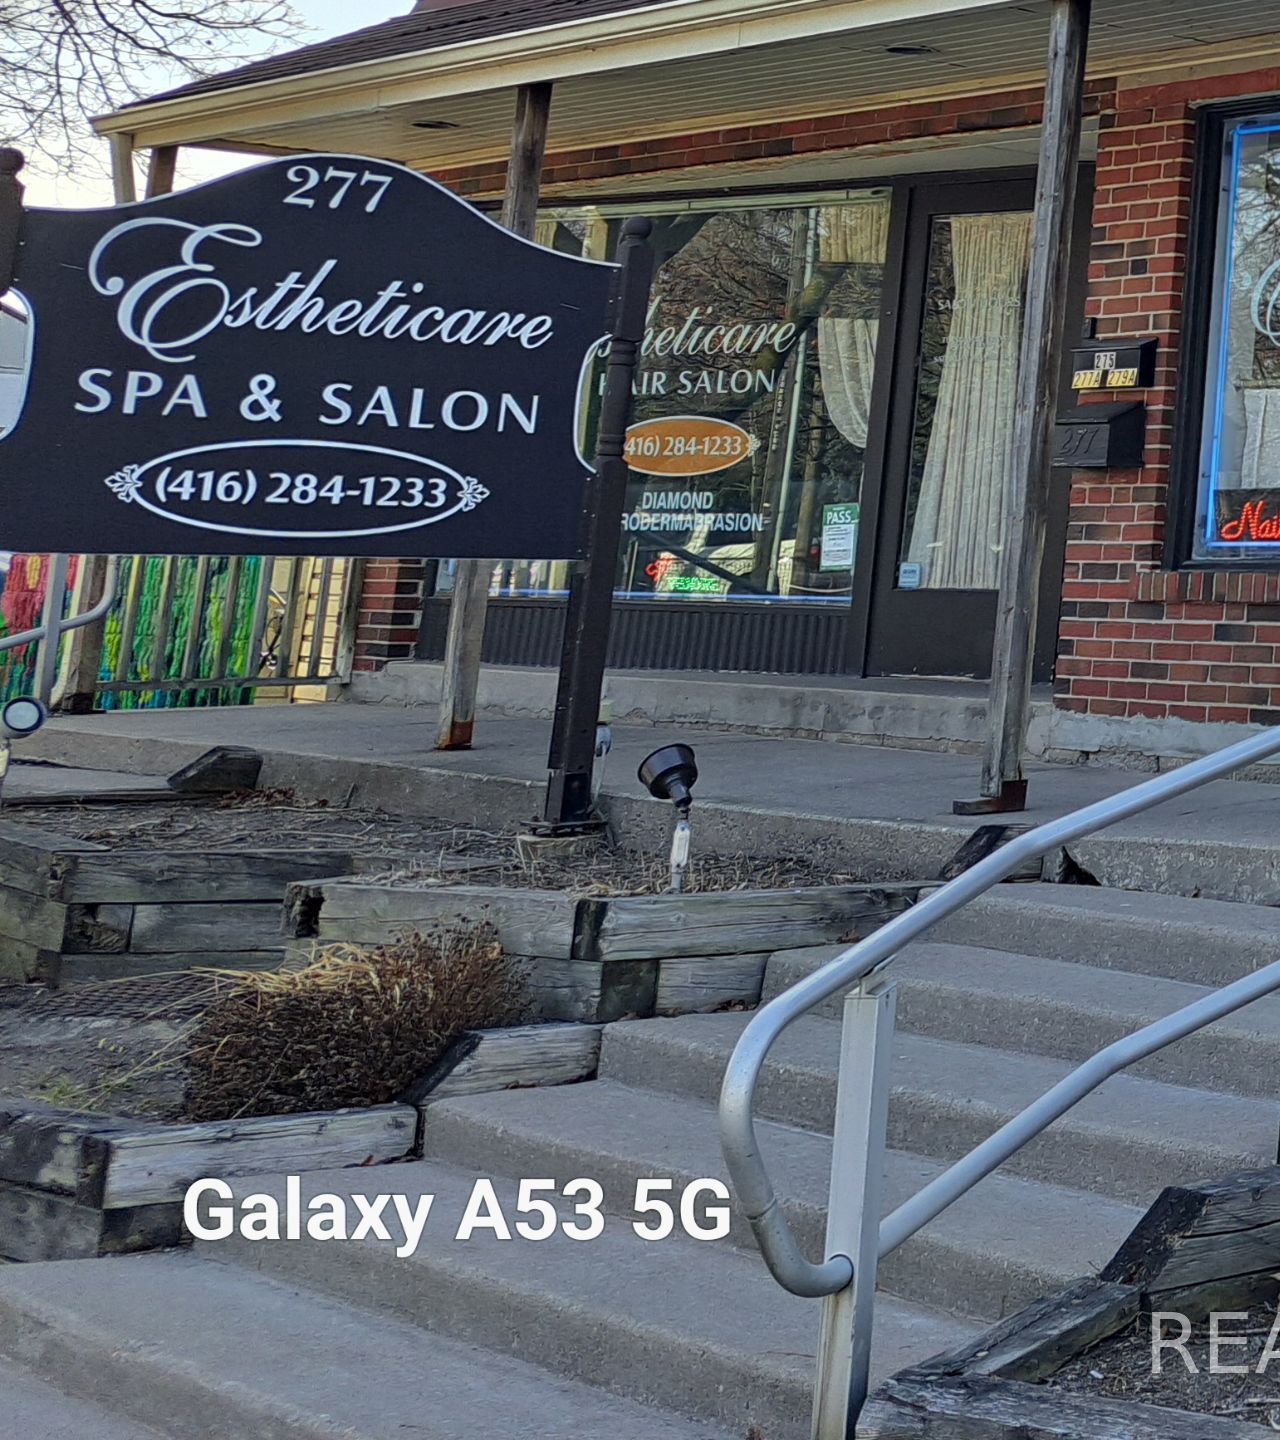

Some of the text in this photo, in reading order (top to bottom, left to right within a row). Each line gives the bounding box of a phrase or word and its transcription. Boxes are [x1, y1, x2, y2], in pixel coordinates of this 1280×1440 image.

[282, 164, 394, 214] 277
[88, 216, 555, 363] Estheticare
[1095, 353, 1115, 369] 275
[678, 368, 776, 395] SALON
[1073, 369, 1135, 388] 277A 279A
[74, 368, 541, 436] SPA & SALON
[624, 435, 743, 458] 416) 284-1233
[1060, 427, 1099, 456] 277
[154, 467, 448, 509] (416) 284-1233
[641, 491, 714, 510] DIAMOND
[621, 512, 764, 532] RODERMABRASION
[826, 510, 852, 525] PASS
